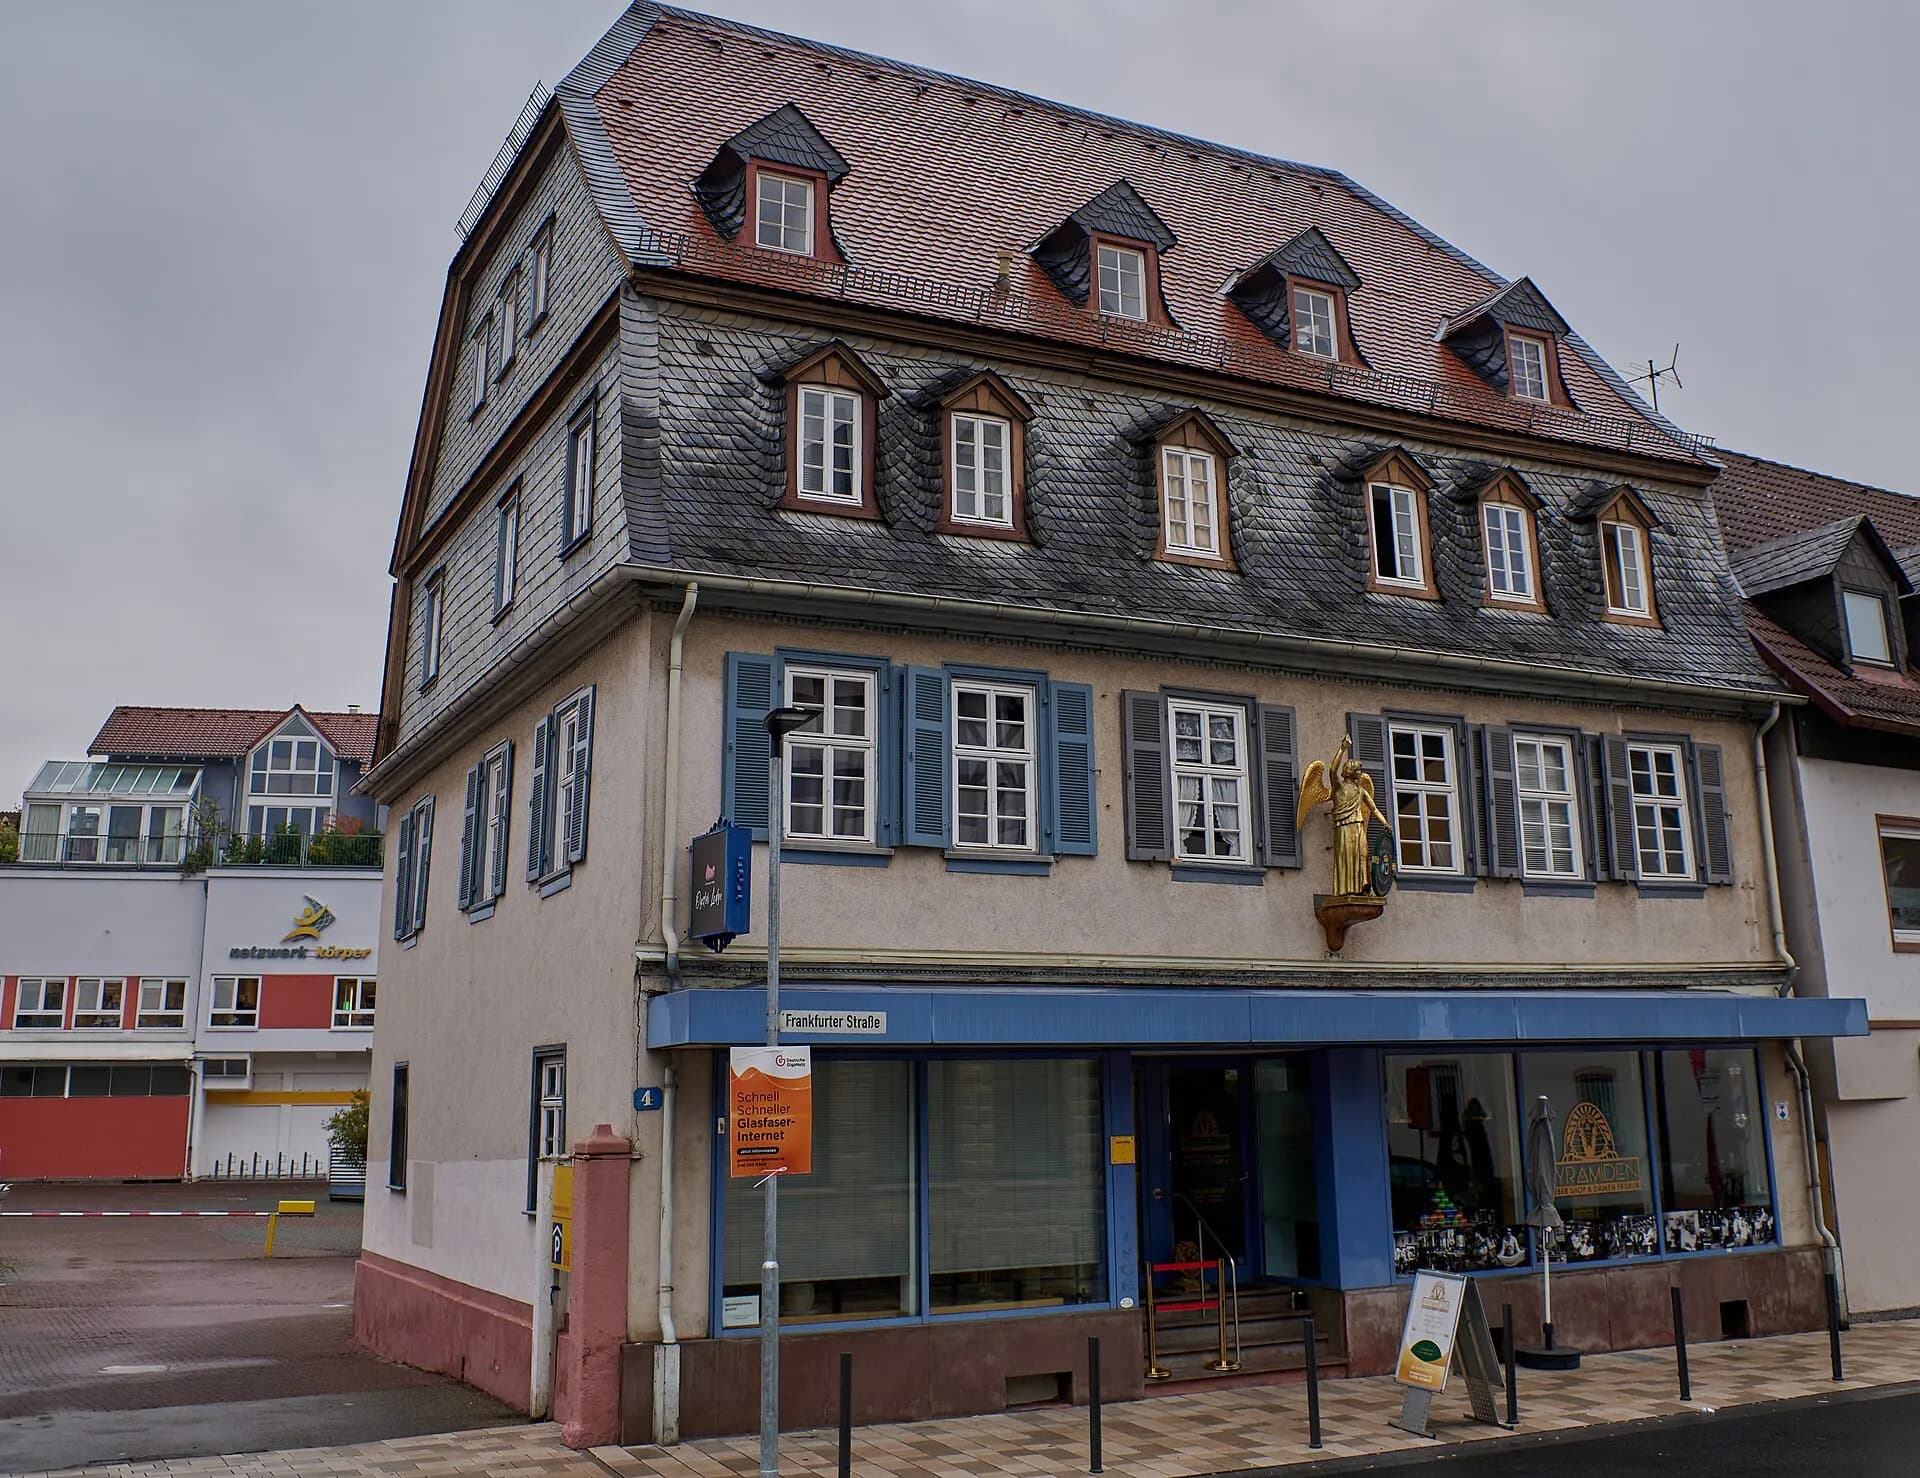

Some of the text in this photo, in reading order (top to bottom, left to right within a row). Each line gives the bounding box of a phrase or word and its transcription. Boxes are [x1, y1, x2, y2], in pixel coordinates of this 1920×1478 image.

[229, 945, 371, 961] netzwerk körper
[785, 1014, 881, 1029] Frankfurter Straße
[641, 1090, 653, 1106] 4
[737, 1090, 780, 1103] Schnell
[737, 1103, 791, 1116] Schneller
[737, 1116, 796, 1129] Glasfaser-
[737, 1130, 785, 1142] Internet
[1555, 1162, 1638, 1185] YRAMIDEN
